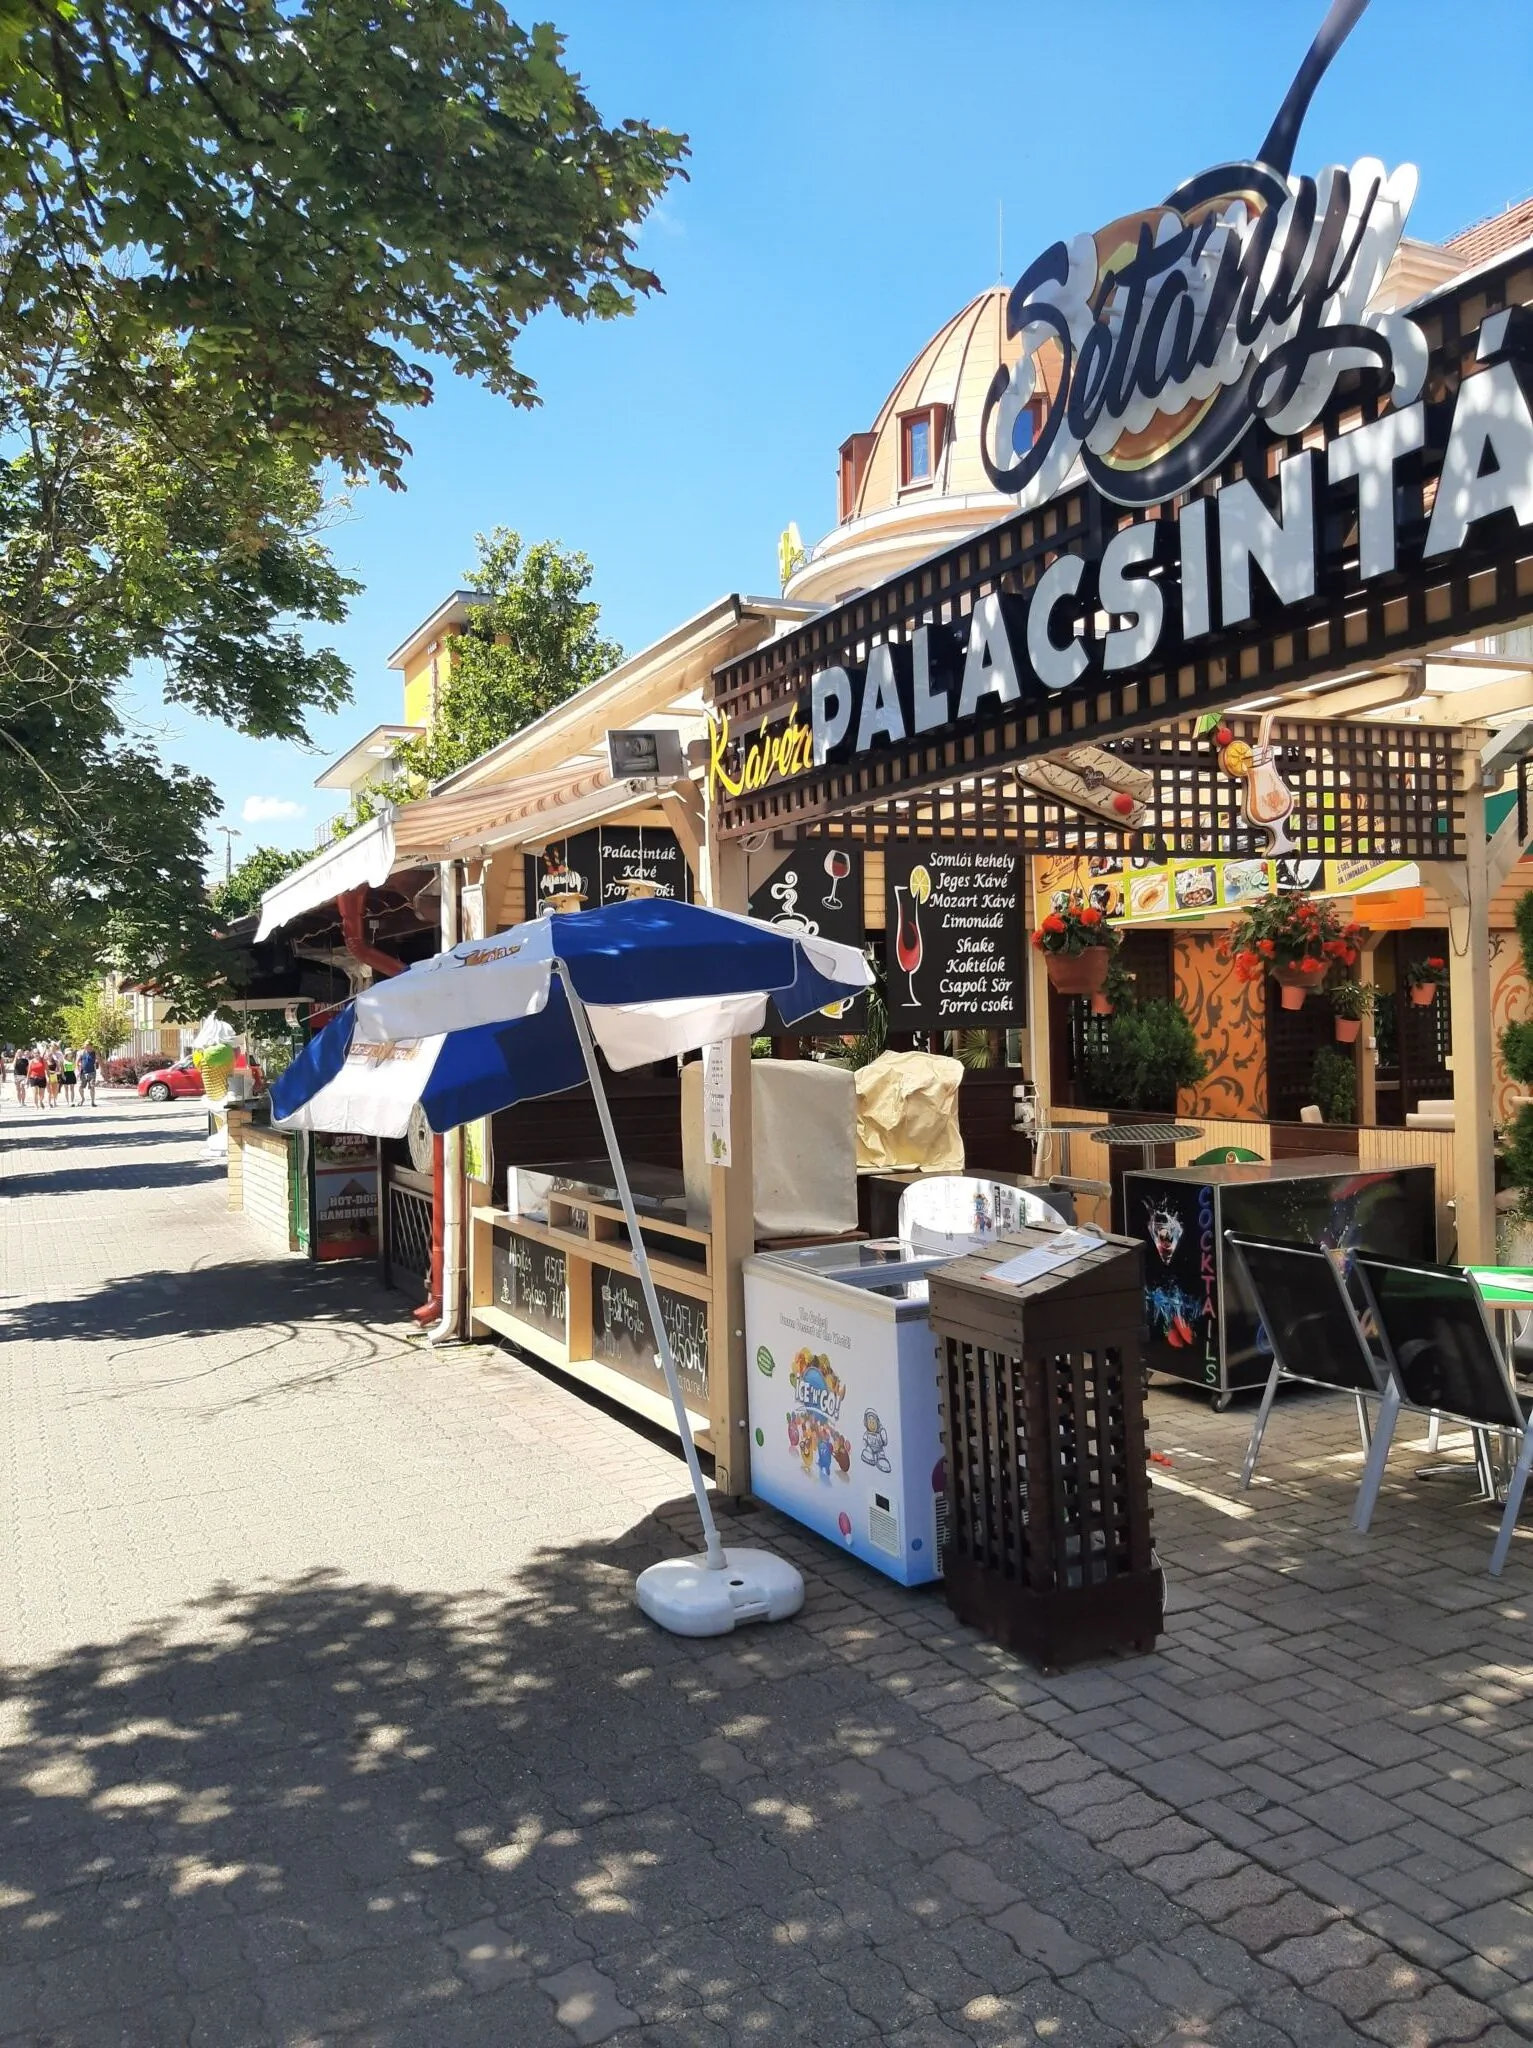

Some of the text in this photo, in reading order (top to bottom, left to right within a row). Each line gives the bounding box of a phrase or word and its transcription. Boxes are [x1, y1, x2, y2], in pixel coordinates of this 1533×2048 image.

[981, 169, 1395, 495] Sétány
[602, 845, 677, 860] Palacsinták
[929, 852, 1015, 873] Somlói kehely
[935, 872, 1008, 893] Jeges Kávé
[929, 893, 1016, 909] Mozart Kávé
[941, 912, 1004, 928] Limonádé
[955, 936, 995, 953] Shake
[945, 956, 1006, 973] Koktélok
[939, 976, 1013, 998] Csapolt Sör
[938, 995, 1014, 1016] Forró csoki
[335, 1135, 369, 1146] PIZZA
[1199, 1186, 1217, 1383] COCKTAILS
